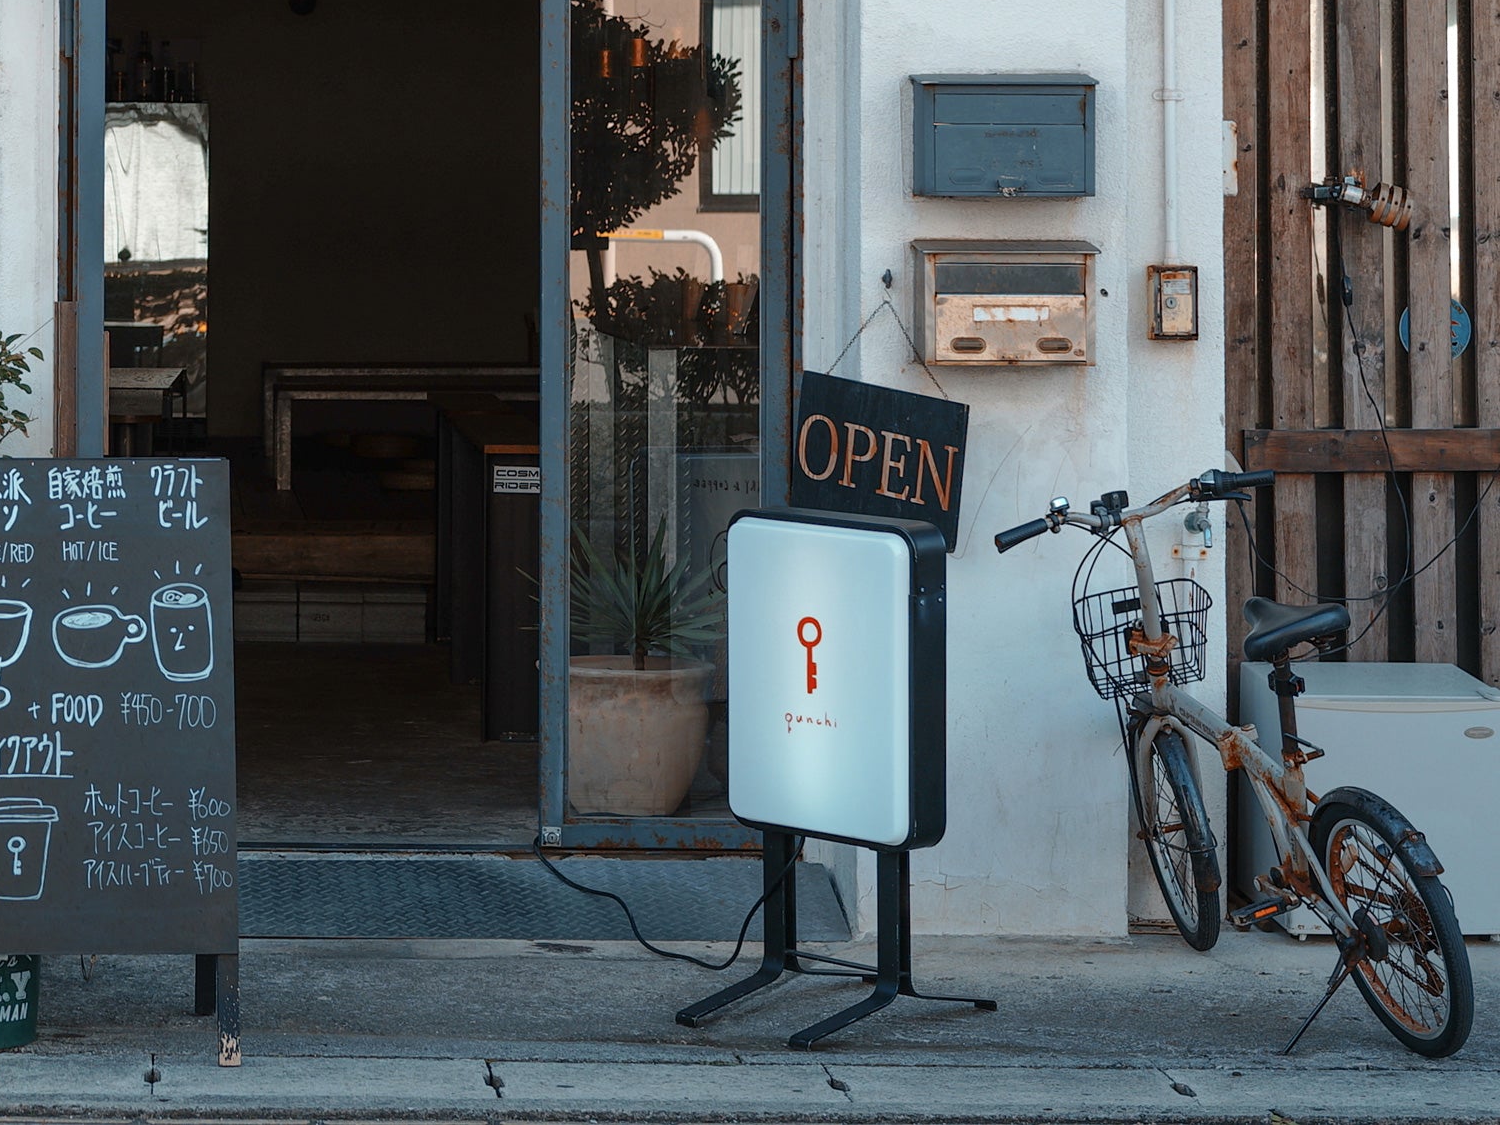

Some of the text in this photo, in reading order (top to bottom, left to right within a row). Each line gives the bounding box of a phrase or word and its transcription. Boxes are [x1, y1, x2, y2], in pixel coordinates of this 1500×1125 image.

[799, 414, 959, 511] OPEN
[48, 465, 126, 500] 自家焙煎
[151, 465, 203, 498] クラフト
[494, 481, 540, 490] RIDER
[60, 501, 117, 530] コーヒー
[159, 499, 208, 529] ビール
[52, 693, 103, 726] FOOD
[83, 783, 231, 821] ホットコーヒー ¥600
[87, 821, 229, 856] アイスコーヒー ¥650
[193, 860, 233, 895] ¥700
